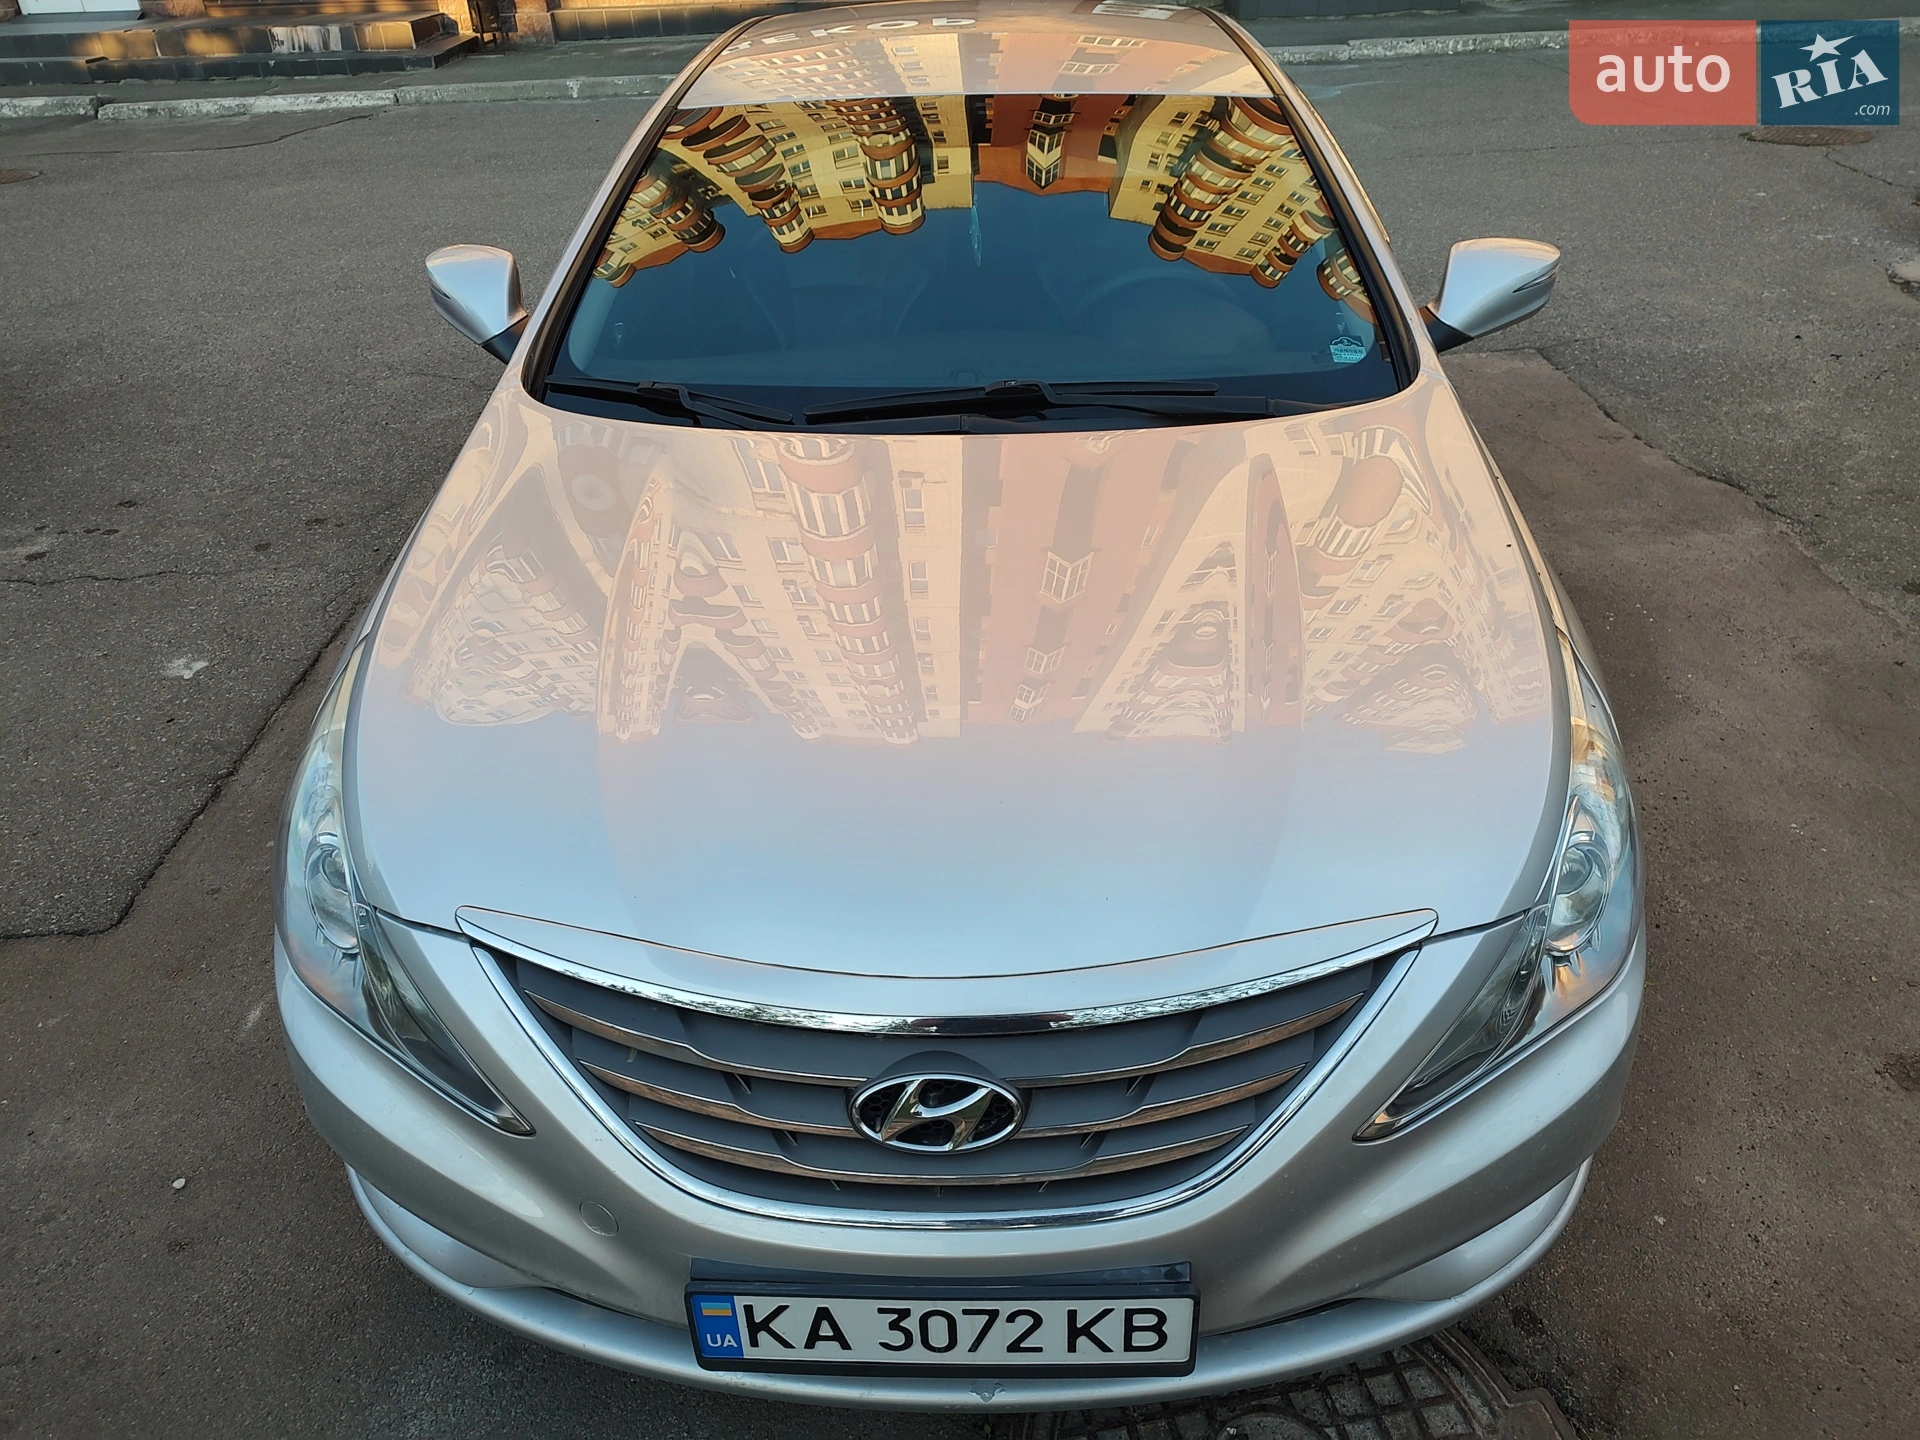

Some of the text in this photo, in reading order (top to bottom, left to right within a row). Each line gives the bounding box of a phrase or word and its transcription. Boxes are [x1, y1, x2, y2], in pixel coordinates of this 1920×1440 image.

[707, 1333, 738, 1349] UA
[743, 1303, 1168, 1353] KA 3072 KB
